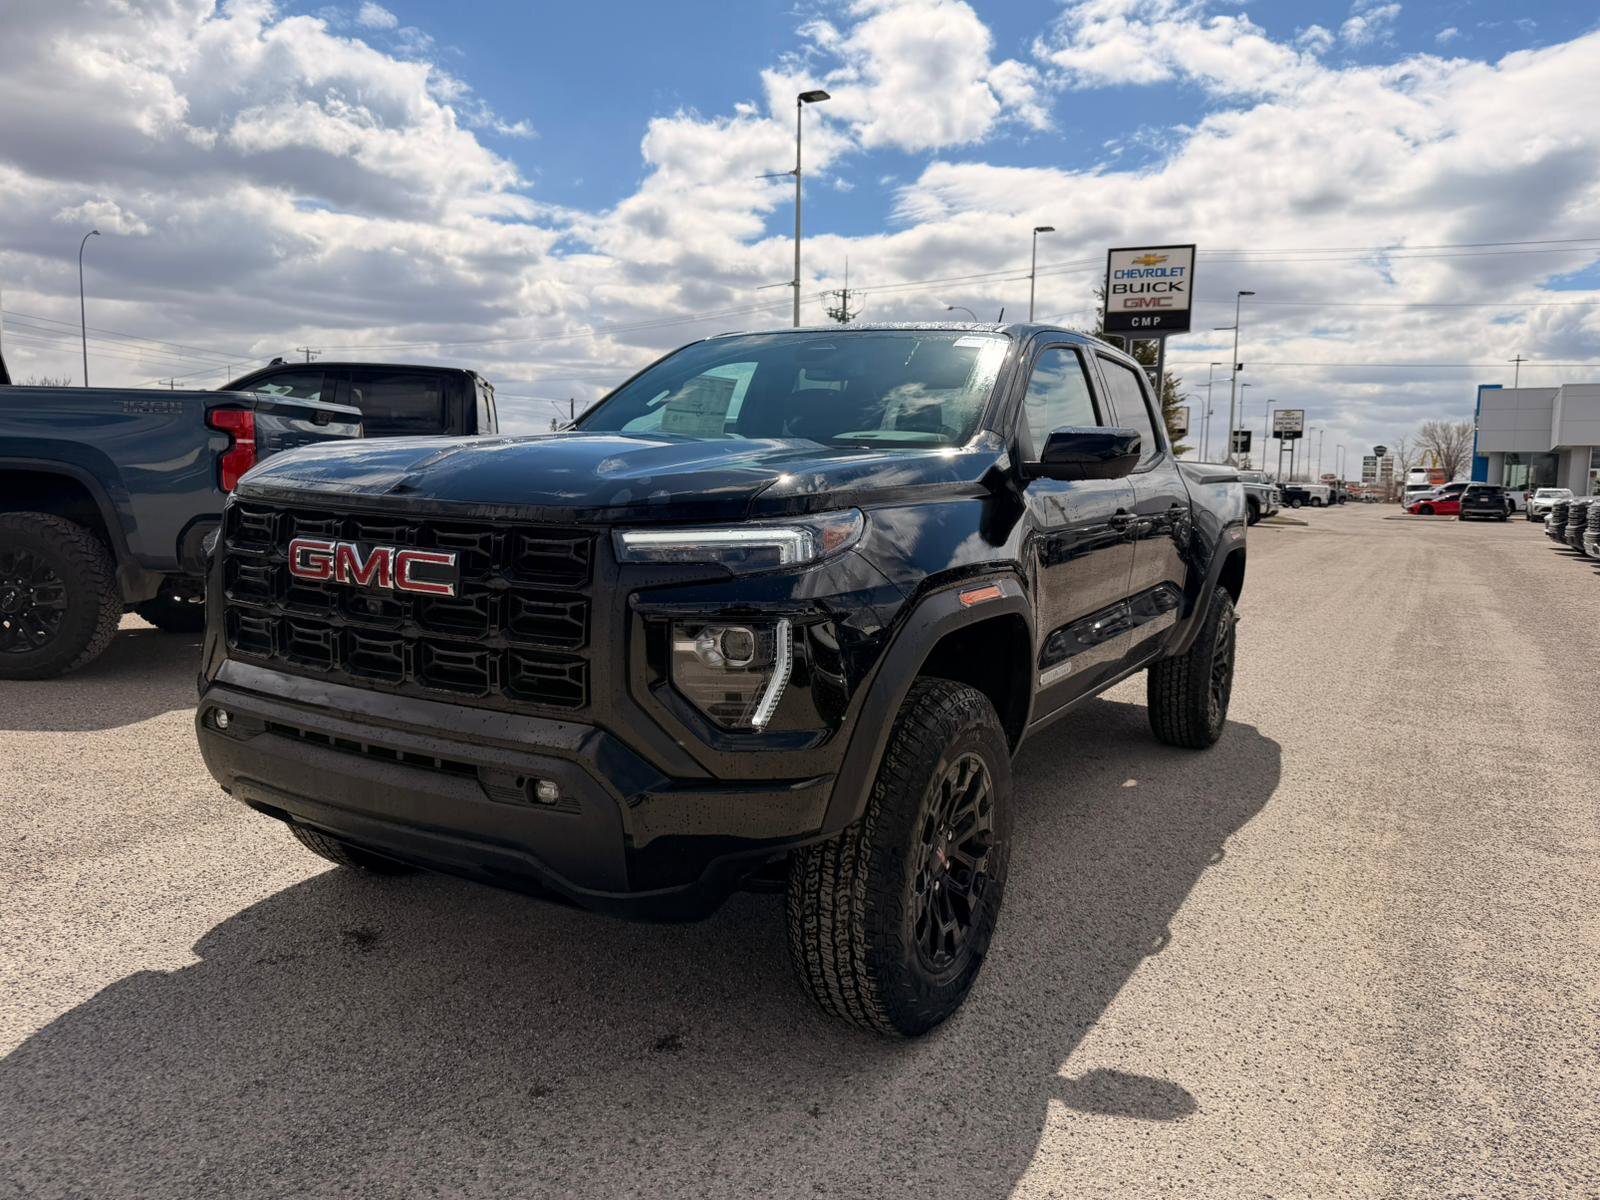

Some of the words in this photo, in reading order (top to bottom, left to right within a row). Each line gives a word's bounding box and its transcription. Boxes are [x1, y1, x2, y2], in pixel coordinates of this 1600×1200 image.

[1114, 267, 1185, 279] CHEVROLET
[1112, 281, 1184, 294] BUICK
[1123, 296, 1173, 308] GMC
[1131, 317, 1160, 326] CMP
[289, 538, 456, 597] GMC
